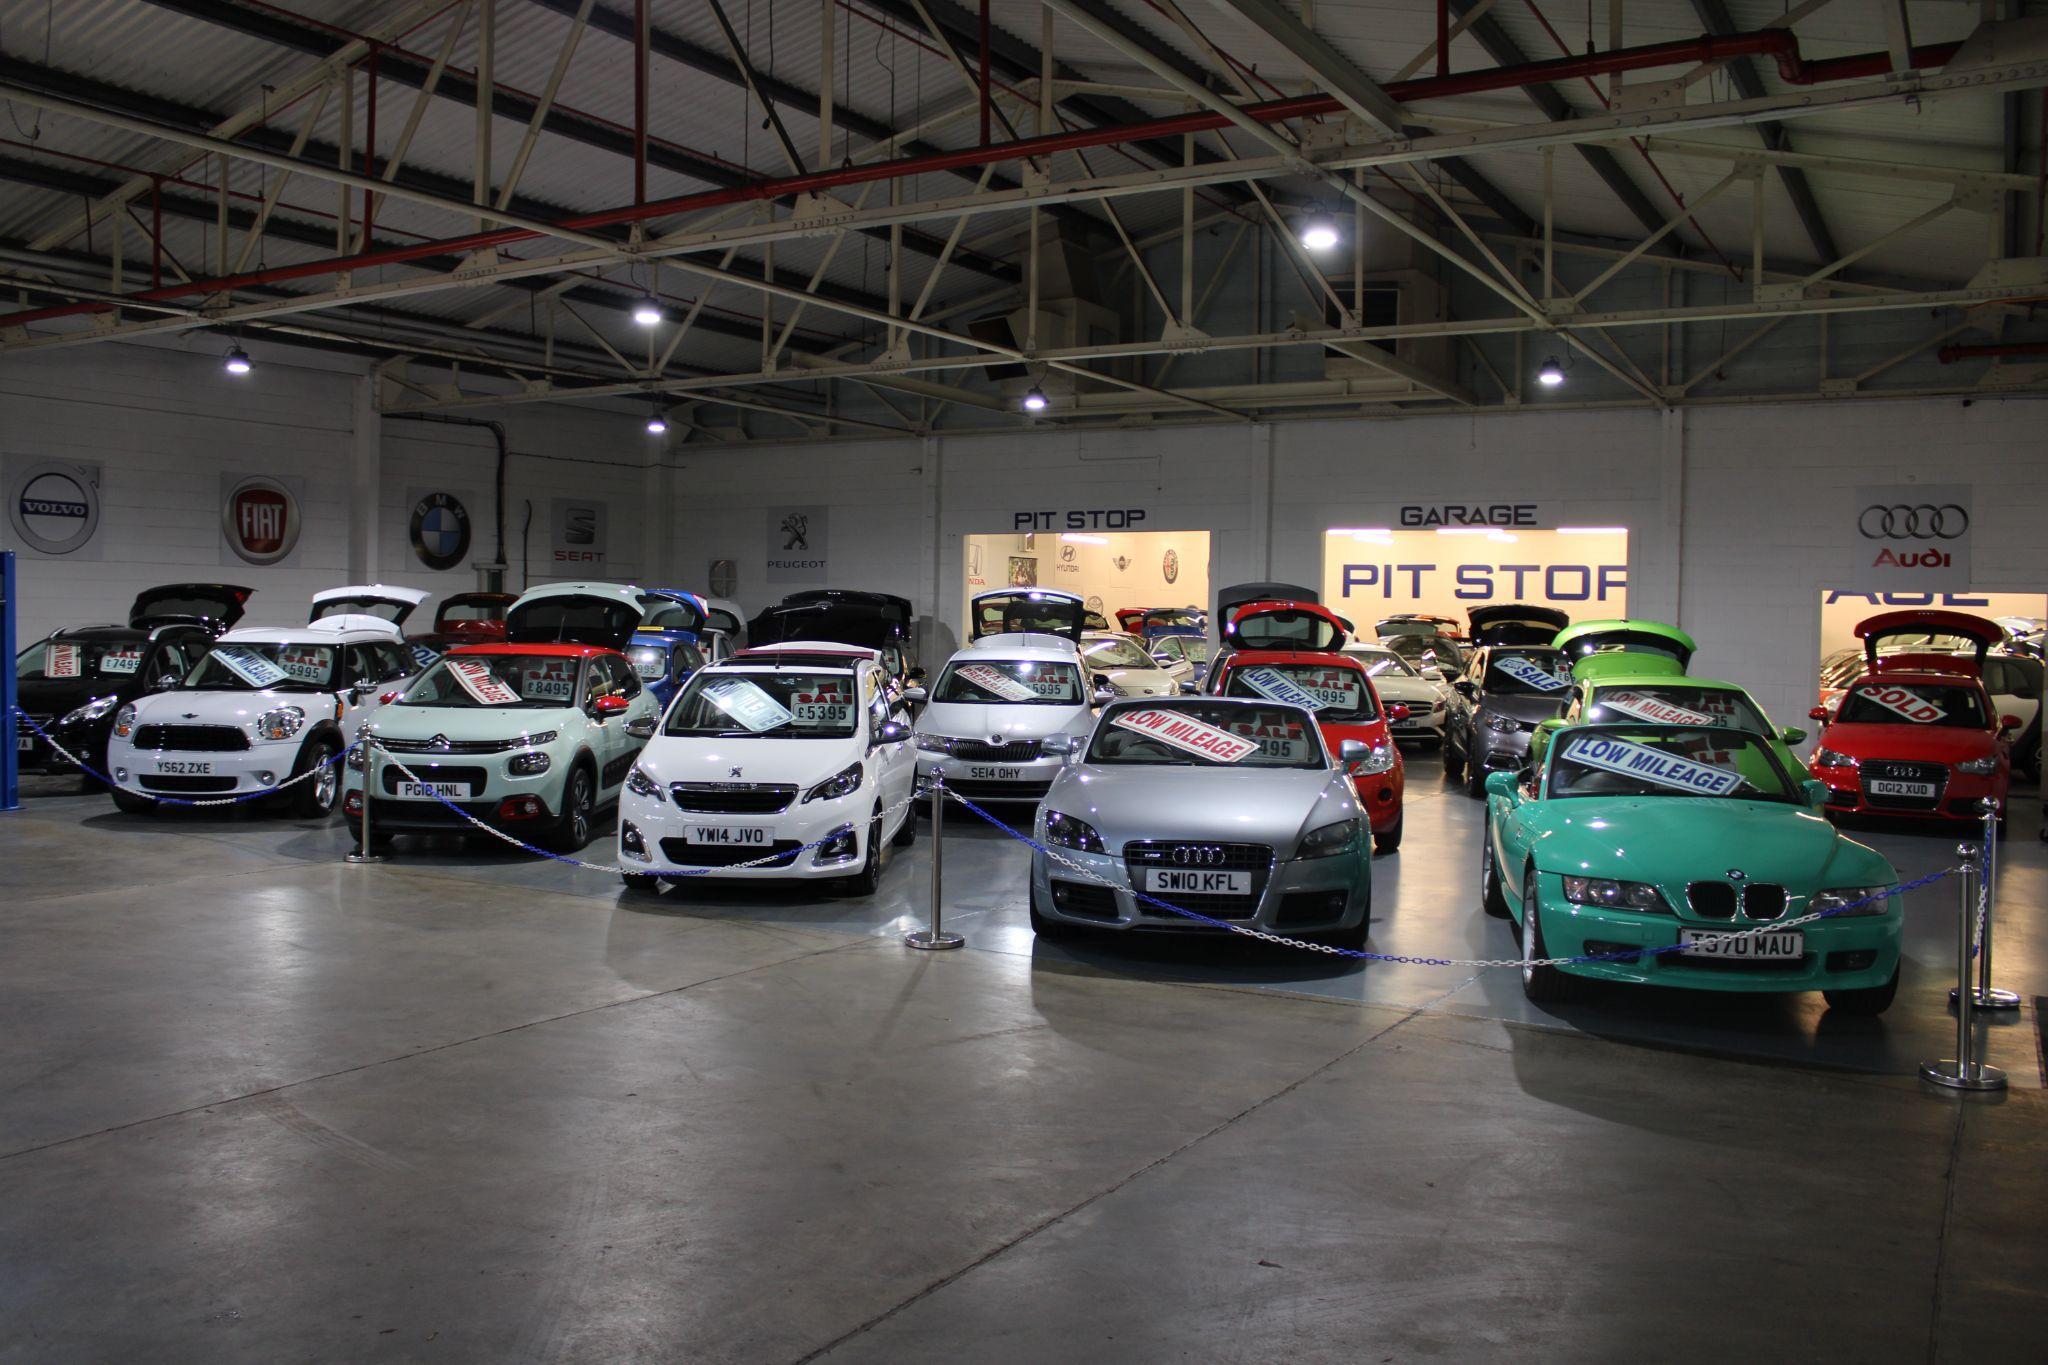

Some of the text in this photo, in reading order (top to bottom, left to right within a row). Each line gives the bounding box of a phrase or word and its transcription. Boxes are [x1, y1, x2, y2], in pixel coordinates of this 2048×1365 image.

[24, 502, 85, 515] VOLVO
[416, 494, 465, 519] BMW
[1400, 504, 1537, 526] GARAGE
[242, 502, 283, 539] FIAT
[1014, 509, 1146, 530] PIT STOP
[554, 550, 605, 562] SEAT
[767, 560, 826, 569] PEUGEOT
[1872, 548, 1950, 567] Audi
[1342, 564, 1436, 599] PIT
[470, 671, 511, 702] MILEAGE
[1248, 667, 1280, 687] LOW
[1514, 666, 1563, 689] SALE
[528, 681, 570, 696] £8495
[1309, 689, 1346, 703] 3995
[798, 705, 847, 720] £5395
[1607, 692, 1702, 725] LOW MILEAGE
[1863, 686, 1939, 720] SOLD
[1126, 710, 1243, 759] LOW MILEAGE
[1255, 739, 1291, 757] 495
[157, 762, 211, 774] YS62 ZXE
[971, 767, 1020, 779] SE14 OHY
[1578, 736, 1729, 791] LOW MILEAGE
[436, 784, 462, 797] HNL
[1878, 782, 1903, 793] DG12
[697, 827, 763, 843] YW14 JVO
[1158, 872, 1239, 890] SW10 KFL
[1754, 935, 1795, 955] MAU
